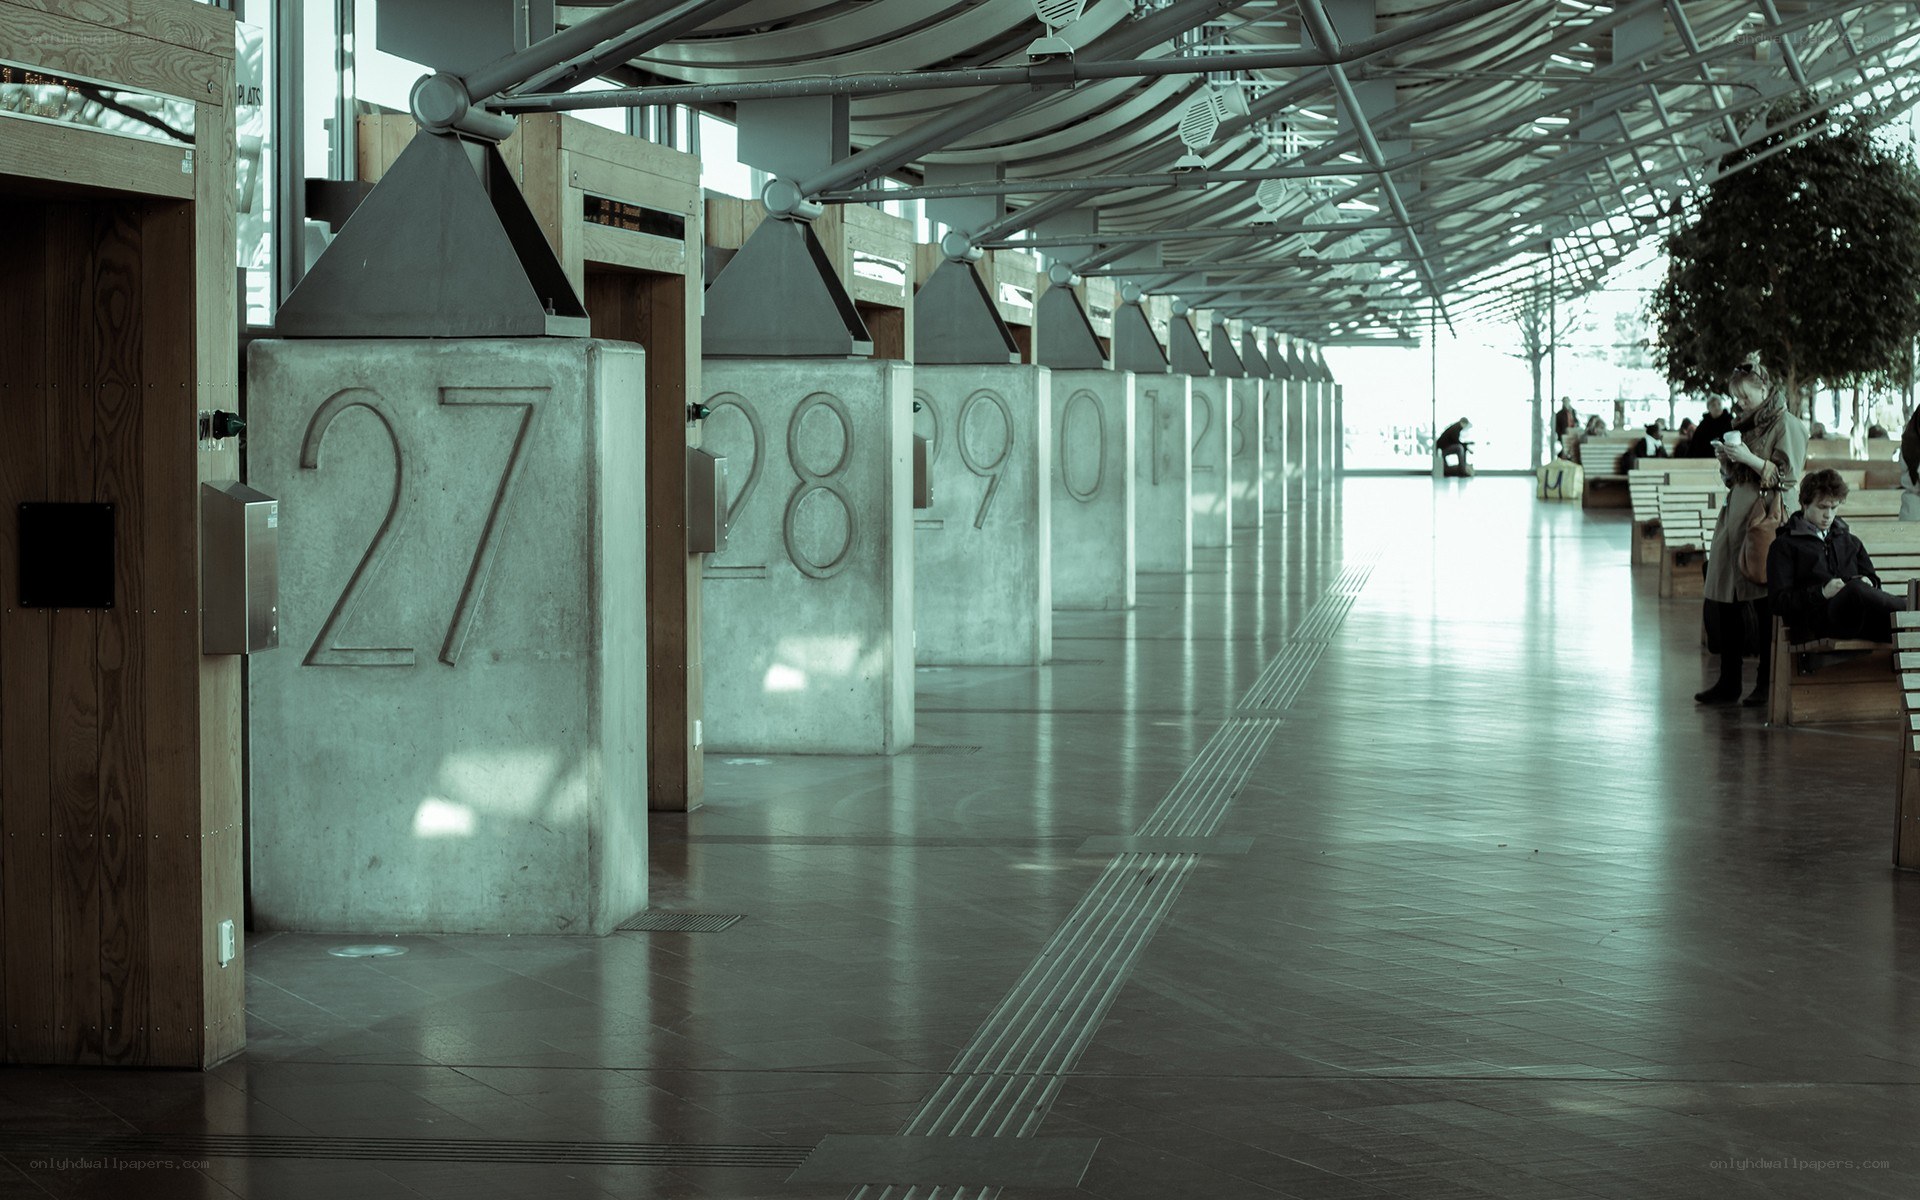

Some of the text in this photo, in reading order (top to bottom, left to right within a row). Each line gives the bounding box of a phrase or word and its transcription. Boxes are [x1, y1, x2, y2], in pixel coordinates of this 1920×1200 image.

[238, 85, 261, 105] PLATS
[702, 391, 859, 580] 28
[1061, 389, 1107, 503] 0
[1145, 390, 1159, 486] 1
[301, 387, 551, 667] 27
